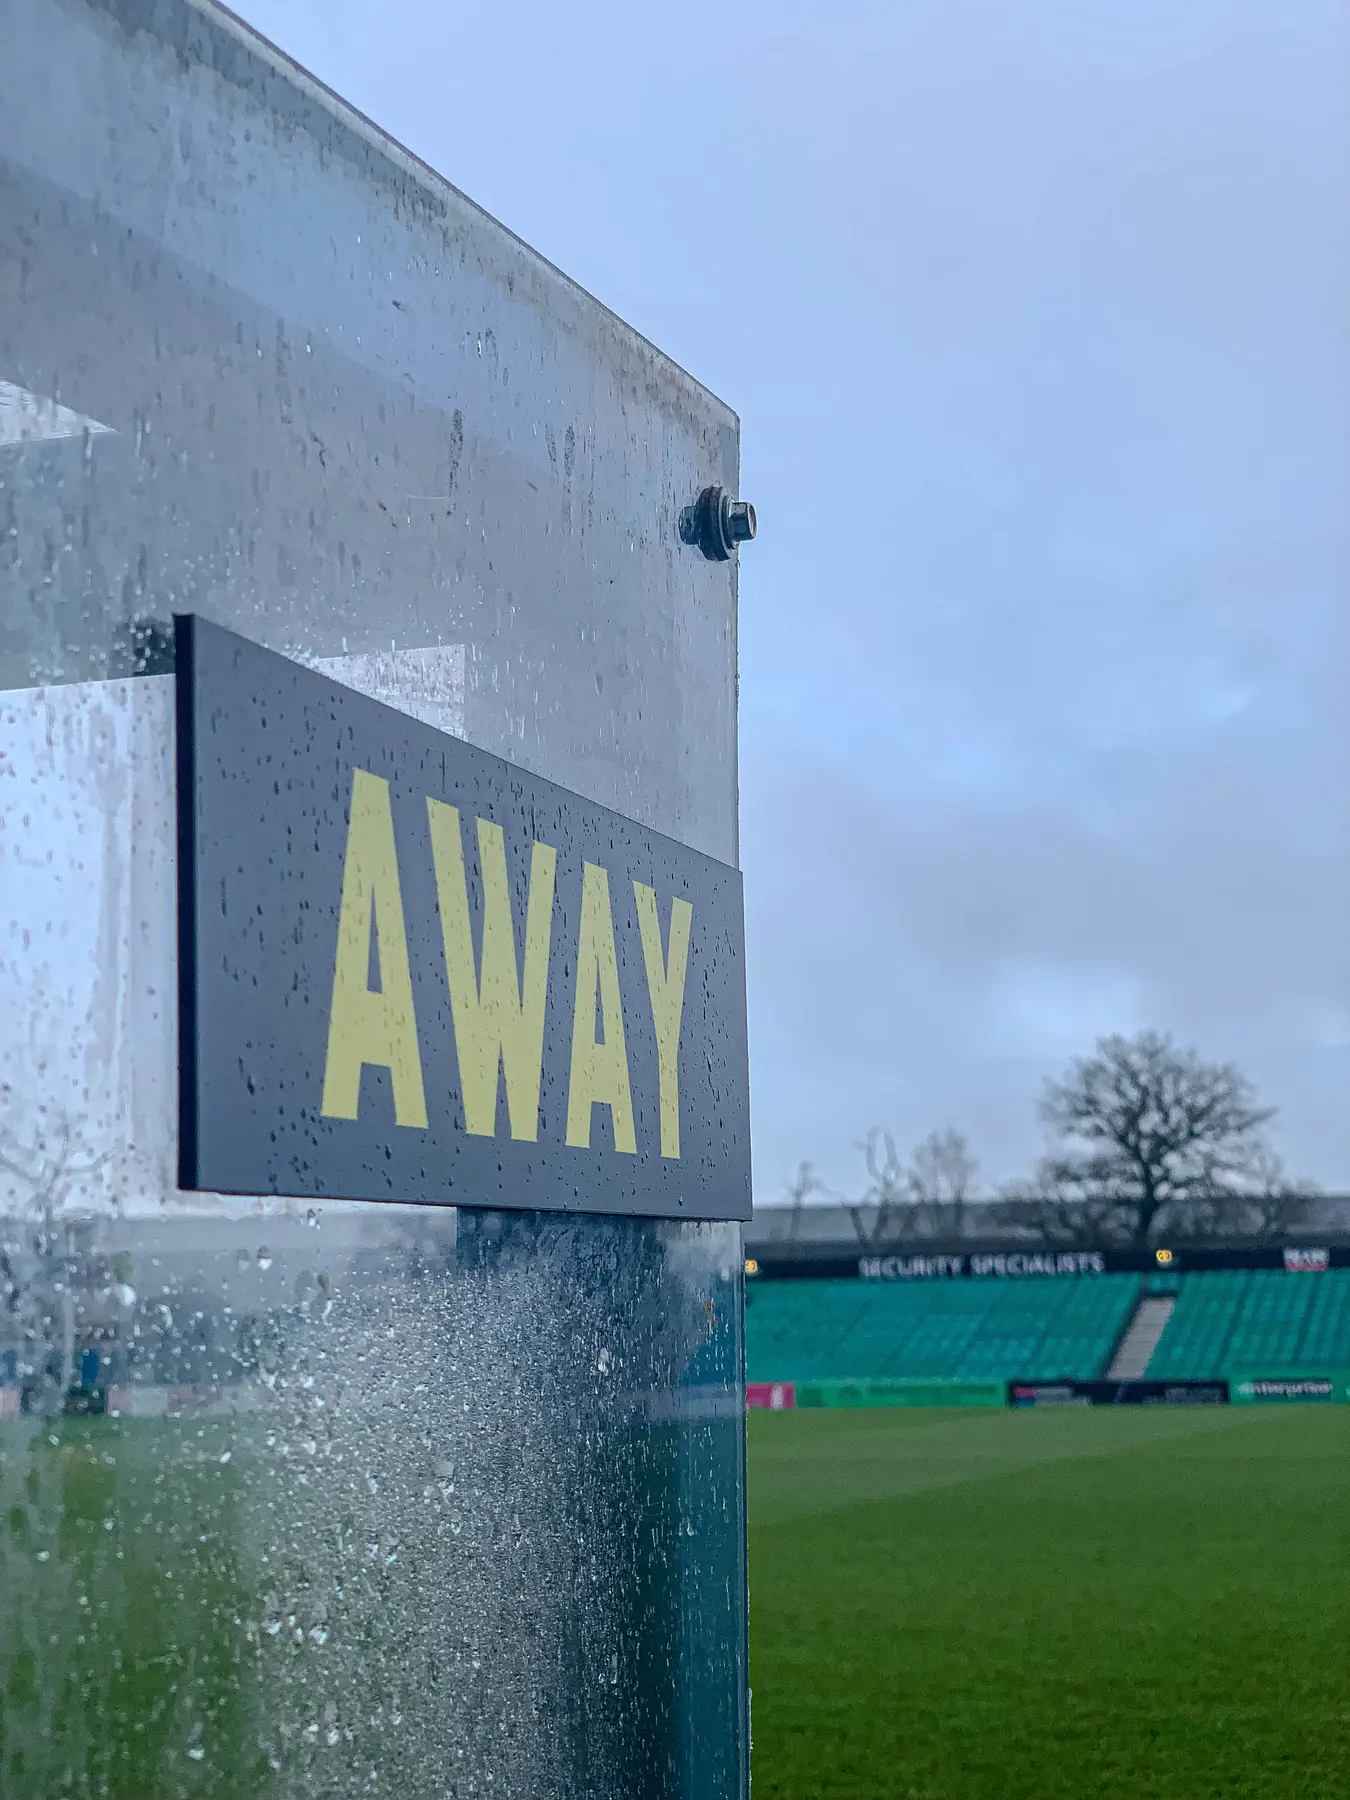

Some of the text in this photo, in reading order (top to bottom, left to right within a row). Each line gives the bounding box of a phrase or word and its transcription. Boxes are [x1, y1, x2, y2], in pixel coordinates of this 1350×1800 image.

[320, 767, 693, 1160] AWAY
[859, 1251, 1104, 1278] SECURITY SPECIALISTS
